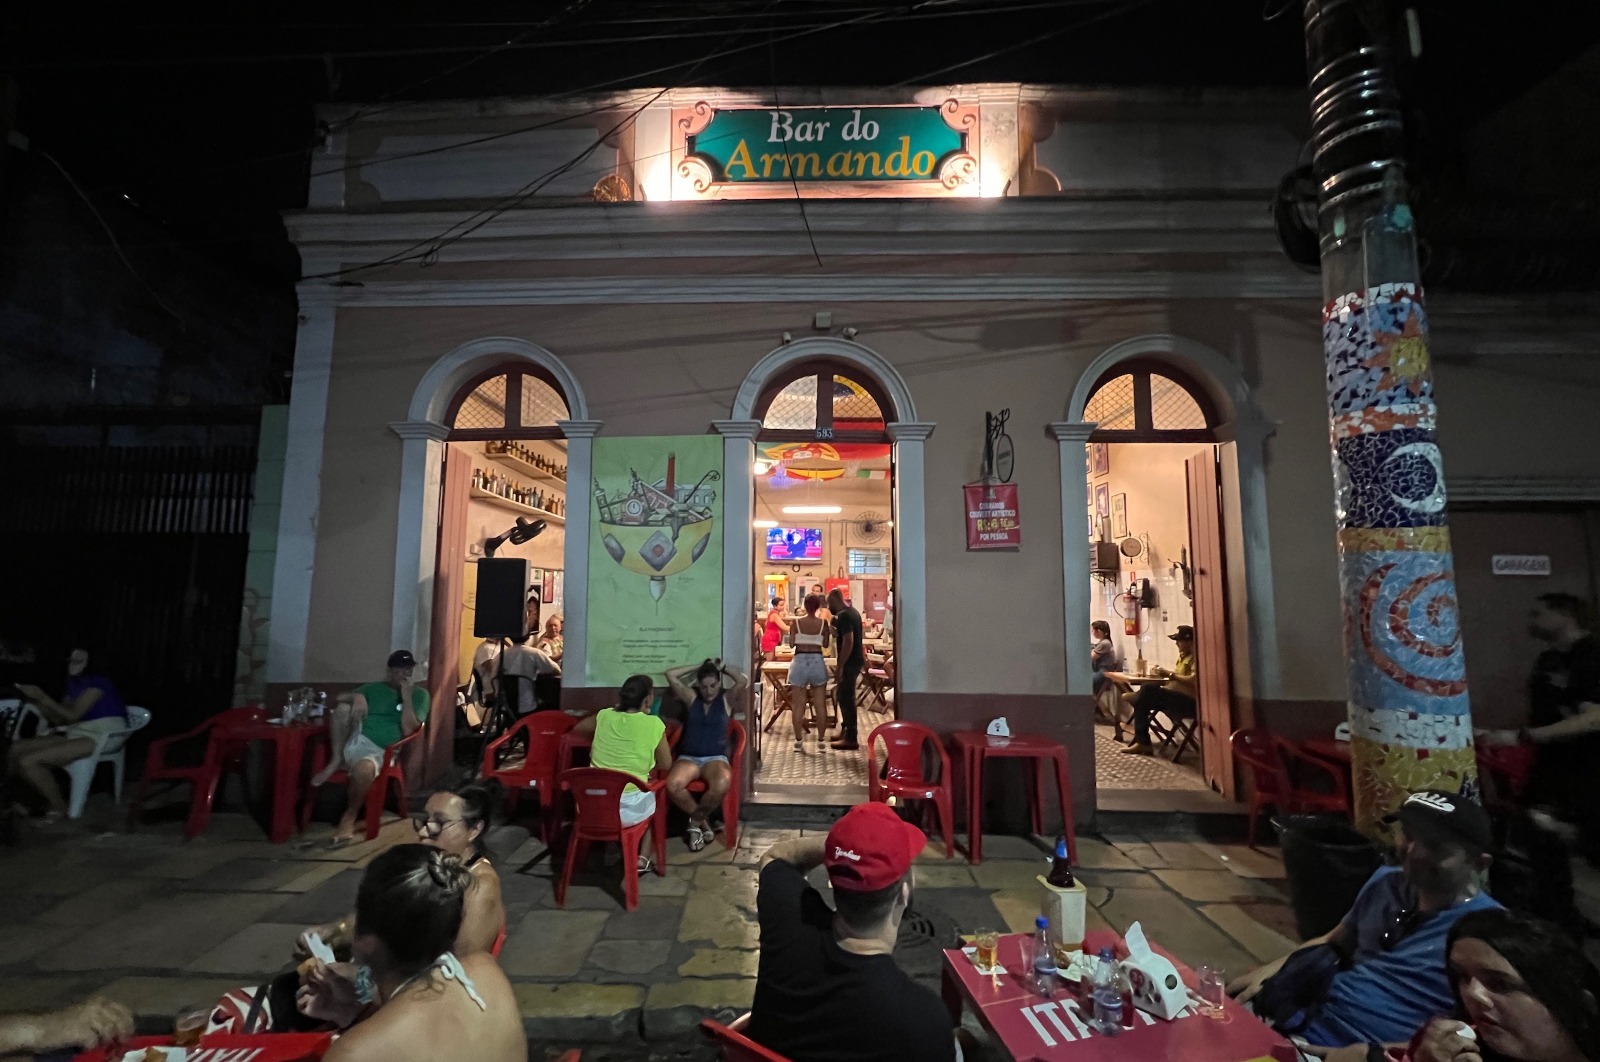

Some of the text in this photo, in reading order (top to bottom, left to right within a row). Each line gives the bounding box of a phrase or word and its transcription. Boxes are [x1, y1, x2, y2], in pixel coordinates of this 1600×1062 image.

[767, 110, 880, 144] Bar do
[722, 136, 936, 179] Armando
[816, 428, 833, 438] 593
